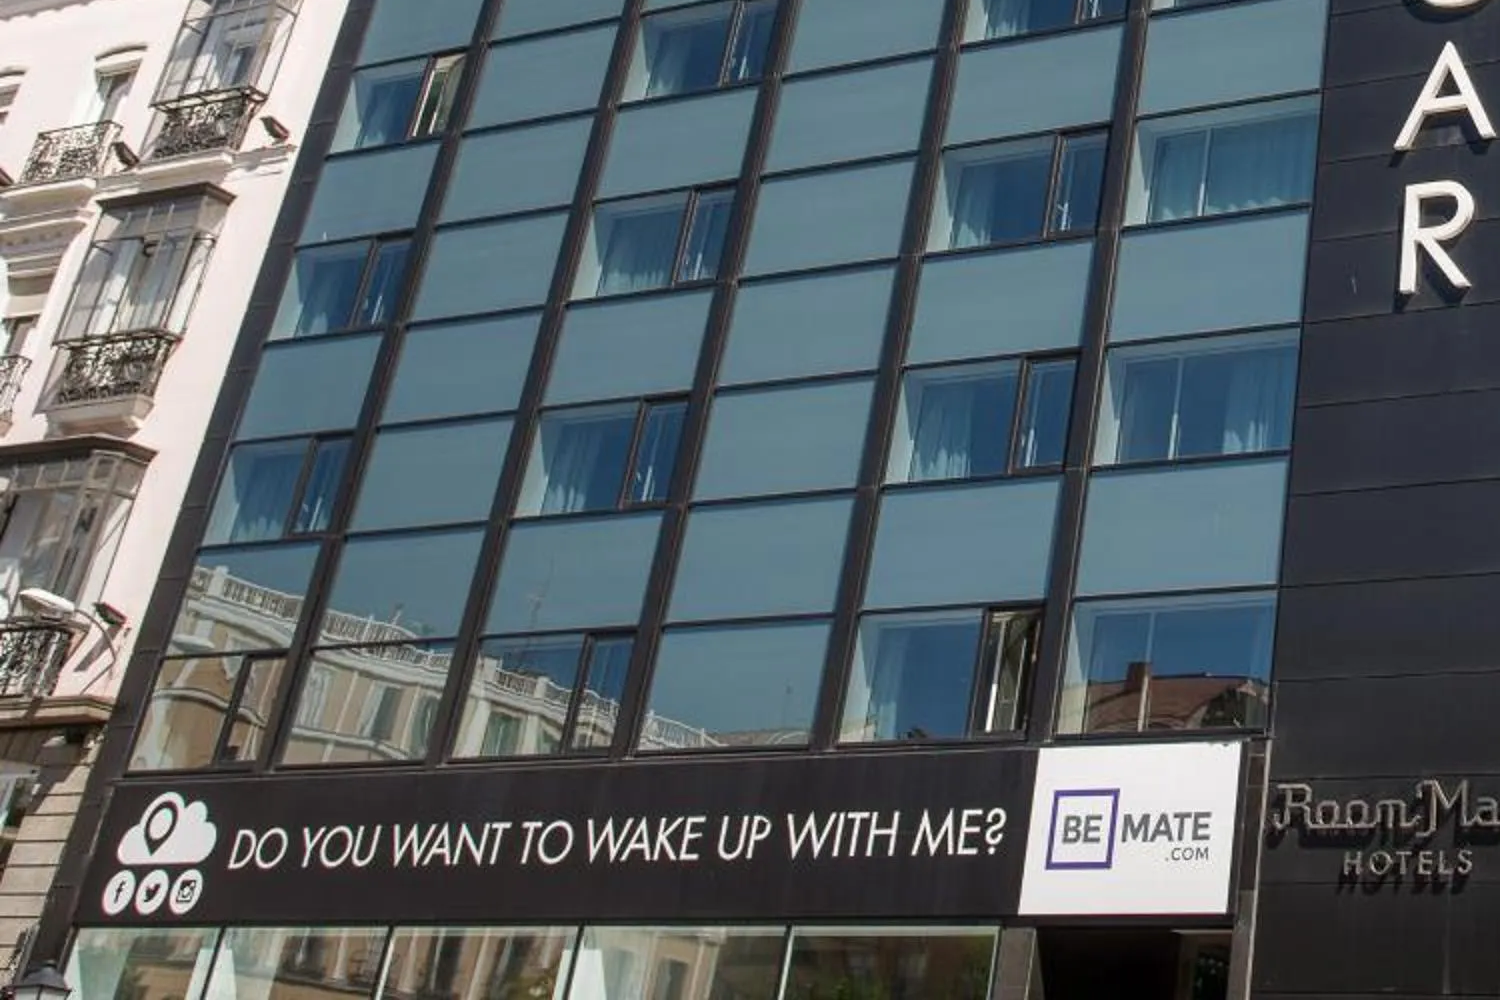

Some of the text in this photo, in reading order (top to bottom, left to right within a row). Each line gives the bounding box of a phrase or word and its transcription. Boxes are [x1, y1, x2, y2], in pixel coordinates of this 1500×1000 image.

[1272, 782, 1421, 830] Room
[227, 807, 1007, 870] DO YOU WANT TO WAKE UP WITH ME?
[1061, 811, 1213, 844] BE MATE
[1166, 847, 1210, 862] .COM
[1343, 850, 1473, 876] HOTELS
